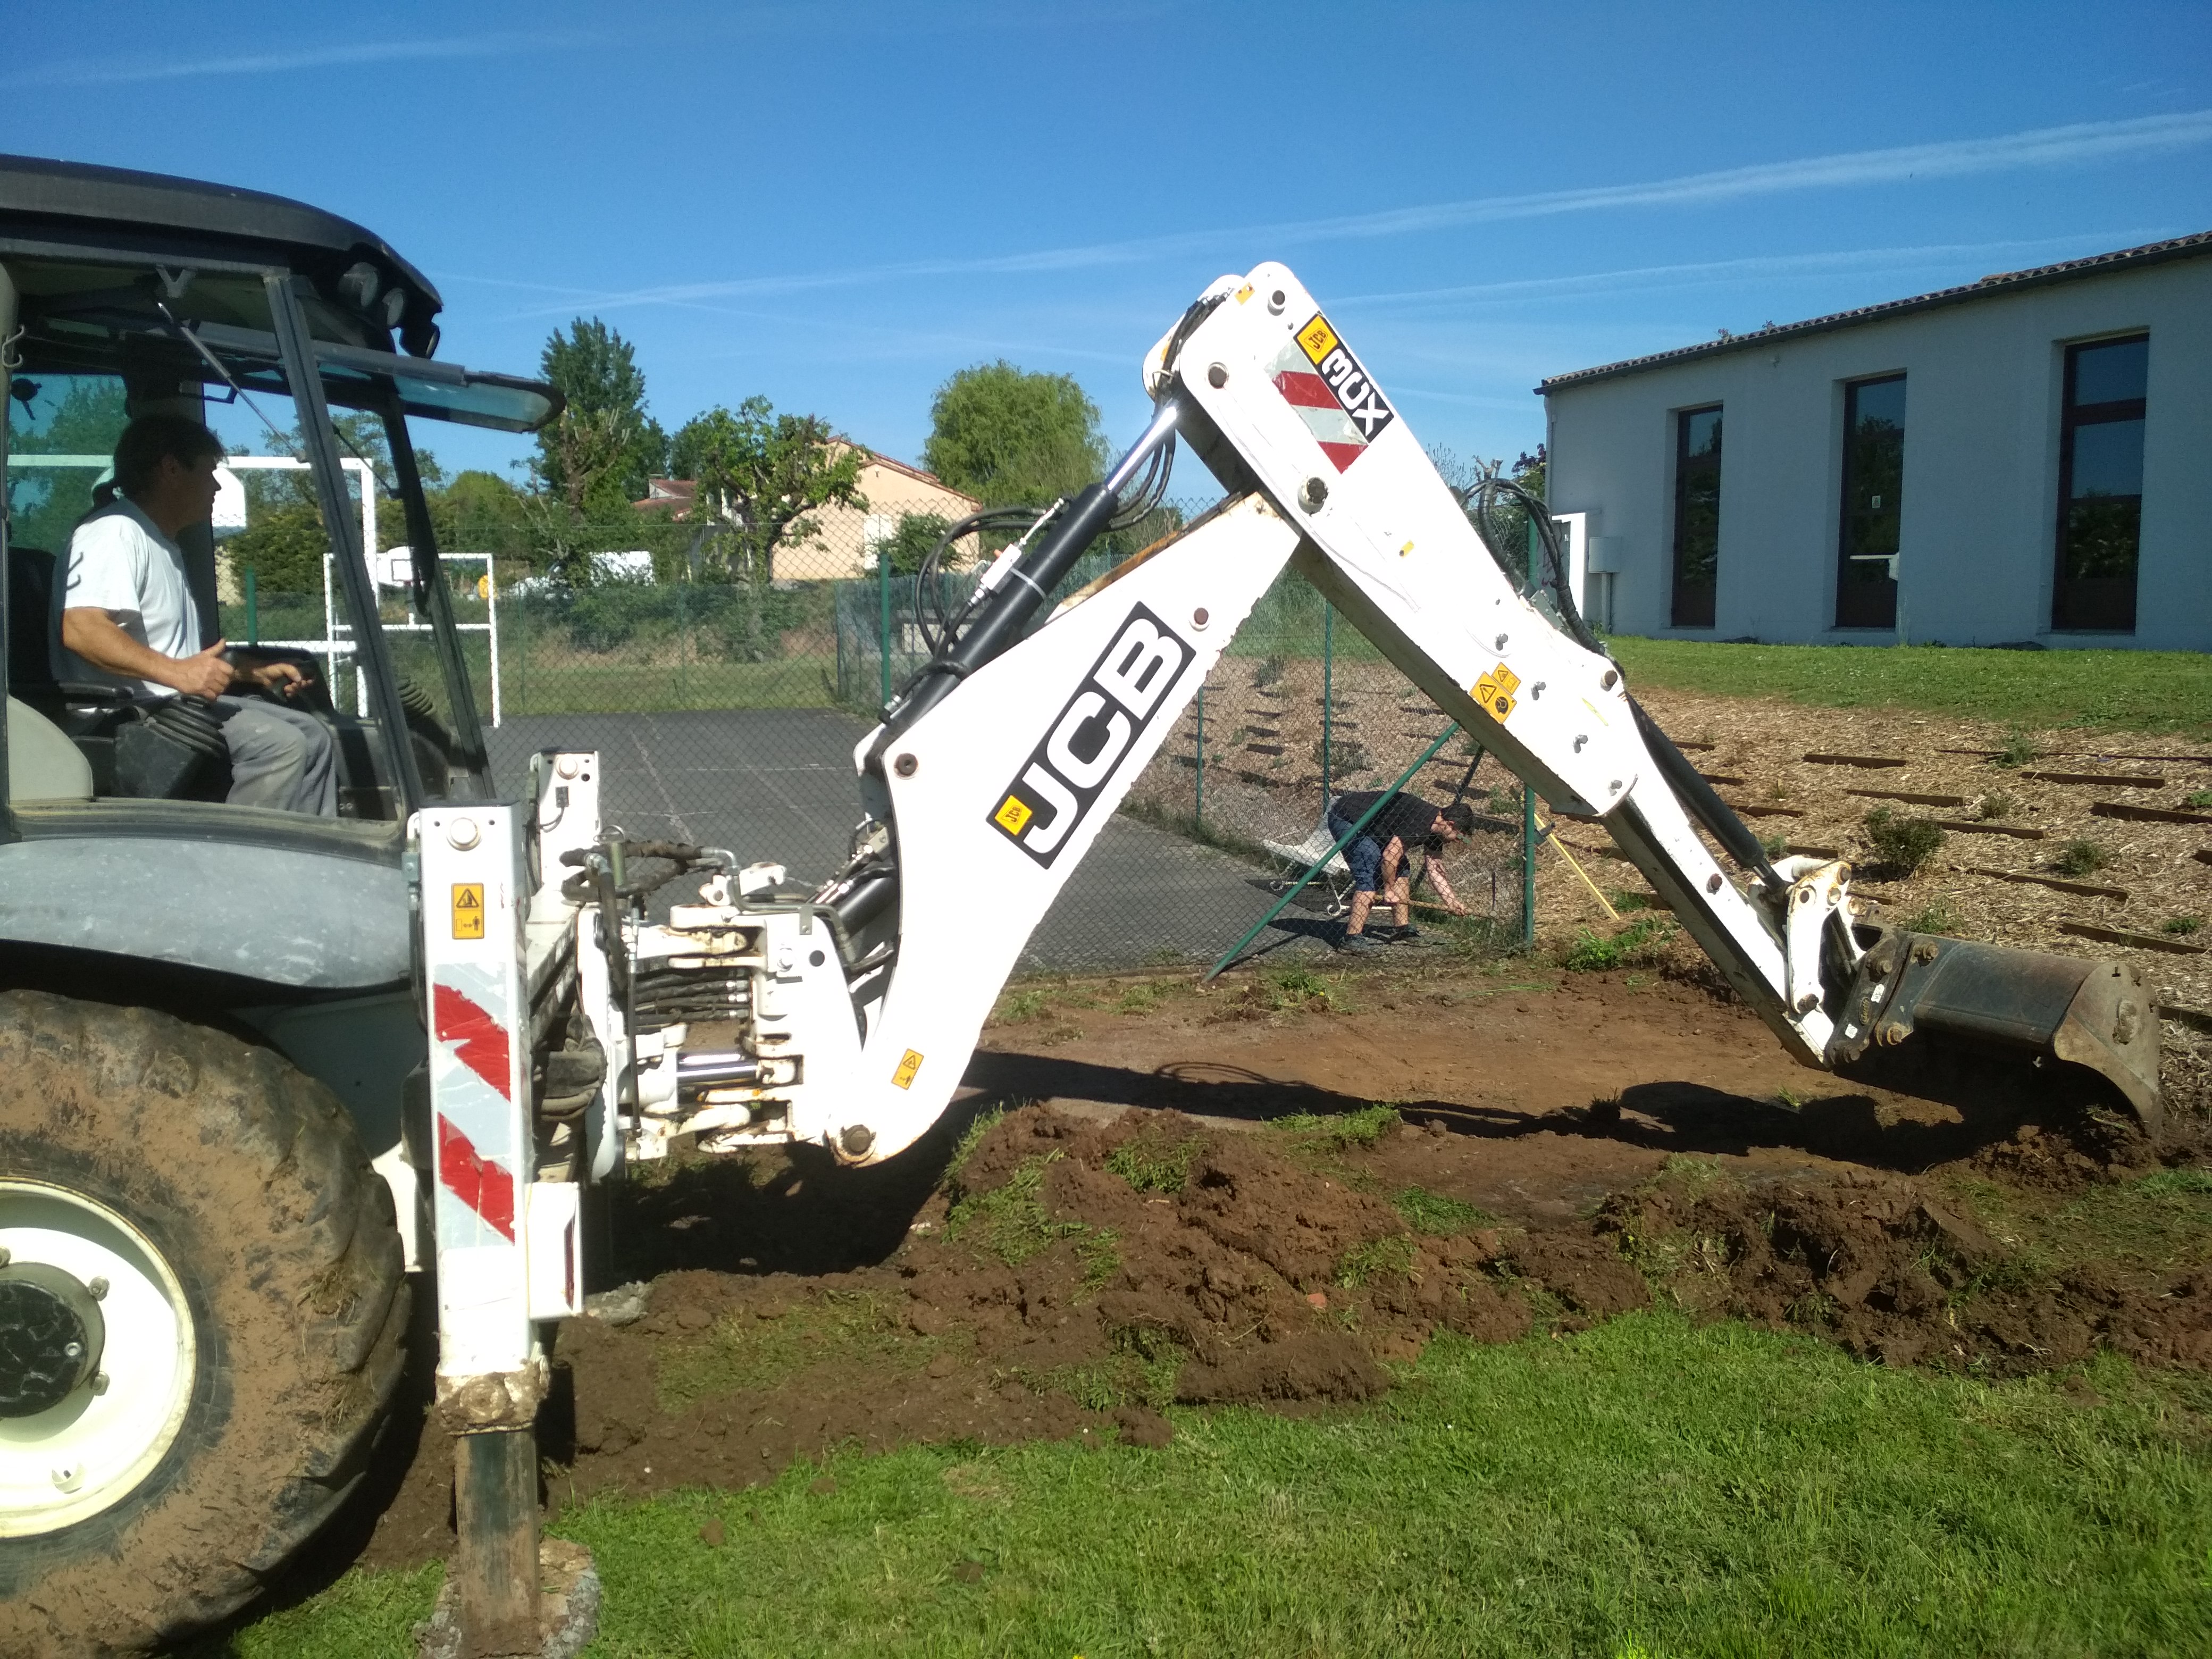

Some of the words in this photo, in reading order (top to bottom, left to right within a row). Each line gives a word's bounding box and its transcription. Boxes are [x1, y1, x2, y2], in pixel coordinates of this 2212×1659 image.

[1309, 330, 1326, 349] JCB
[1322, 349, 1389, 436] 3CX
[1023, 618, 1183, 853] JCB
[1006, 806, 1021, 823] JCB
